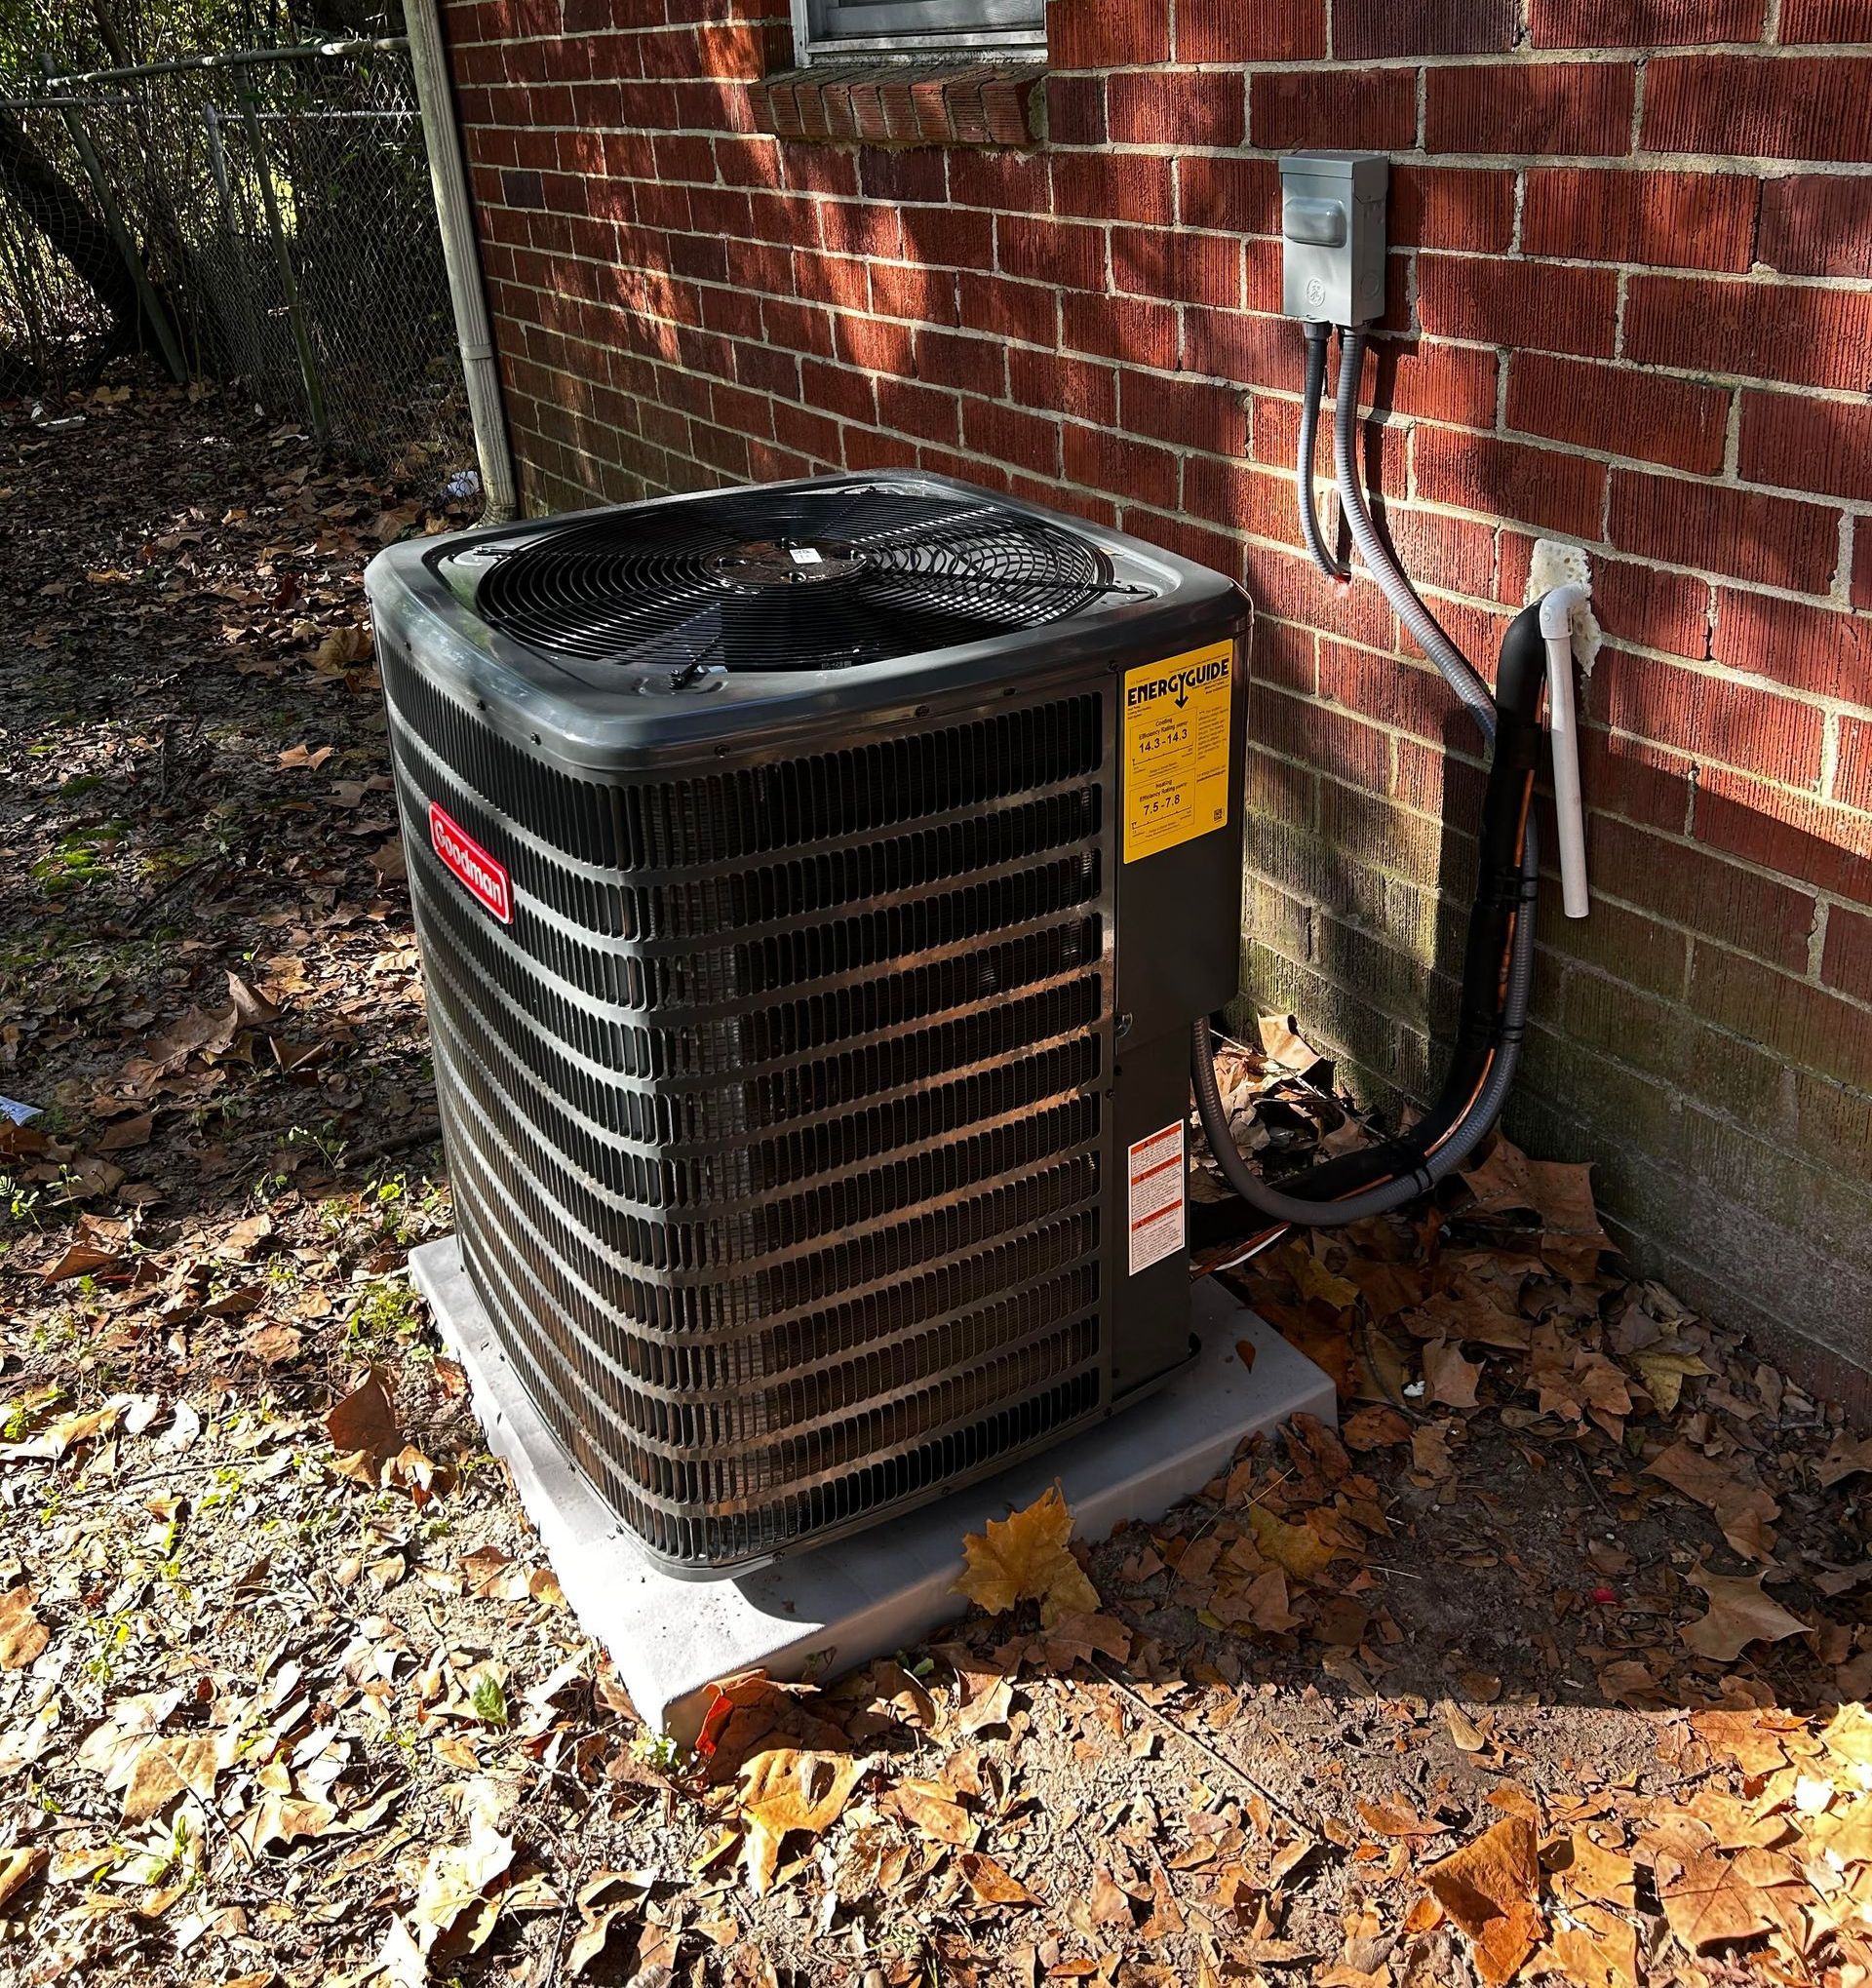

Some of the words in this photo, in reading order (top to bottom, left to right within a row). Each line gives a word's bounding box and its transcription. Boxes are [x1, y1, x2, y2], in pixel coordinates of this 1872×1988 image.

[1127, 658, 1229, 709] ENERGYGUIDE
[1155, 716, 1172, 727] Cooling
[435, 819, 503, 908] Goodman
